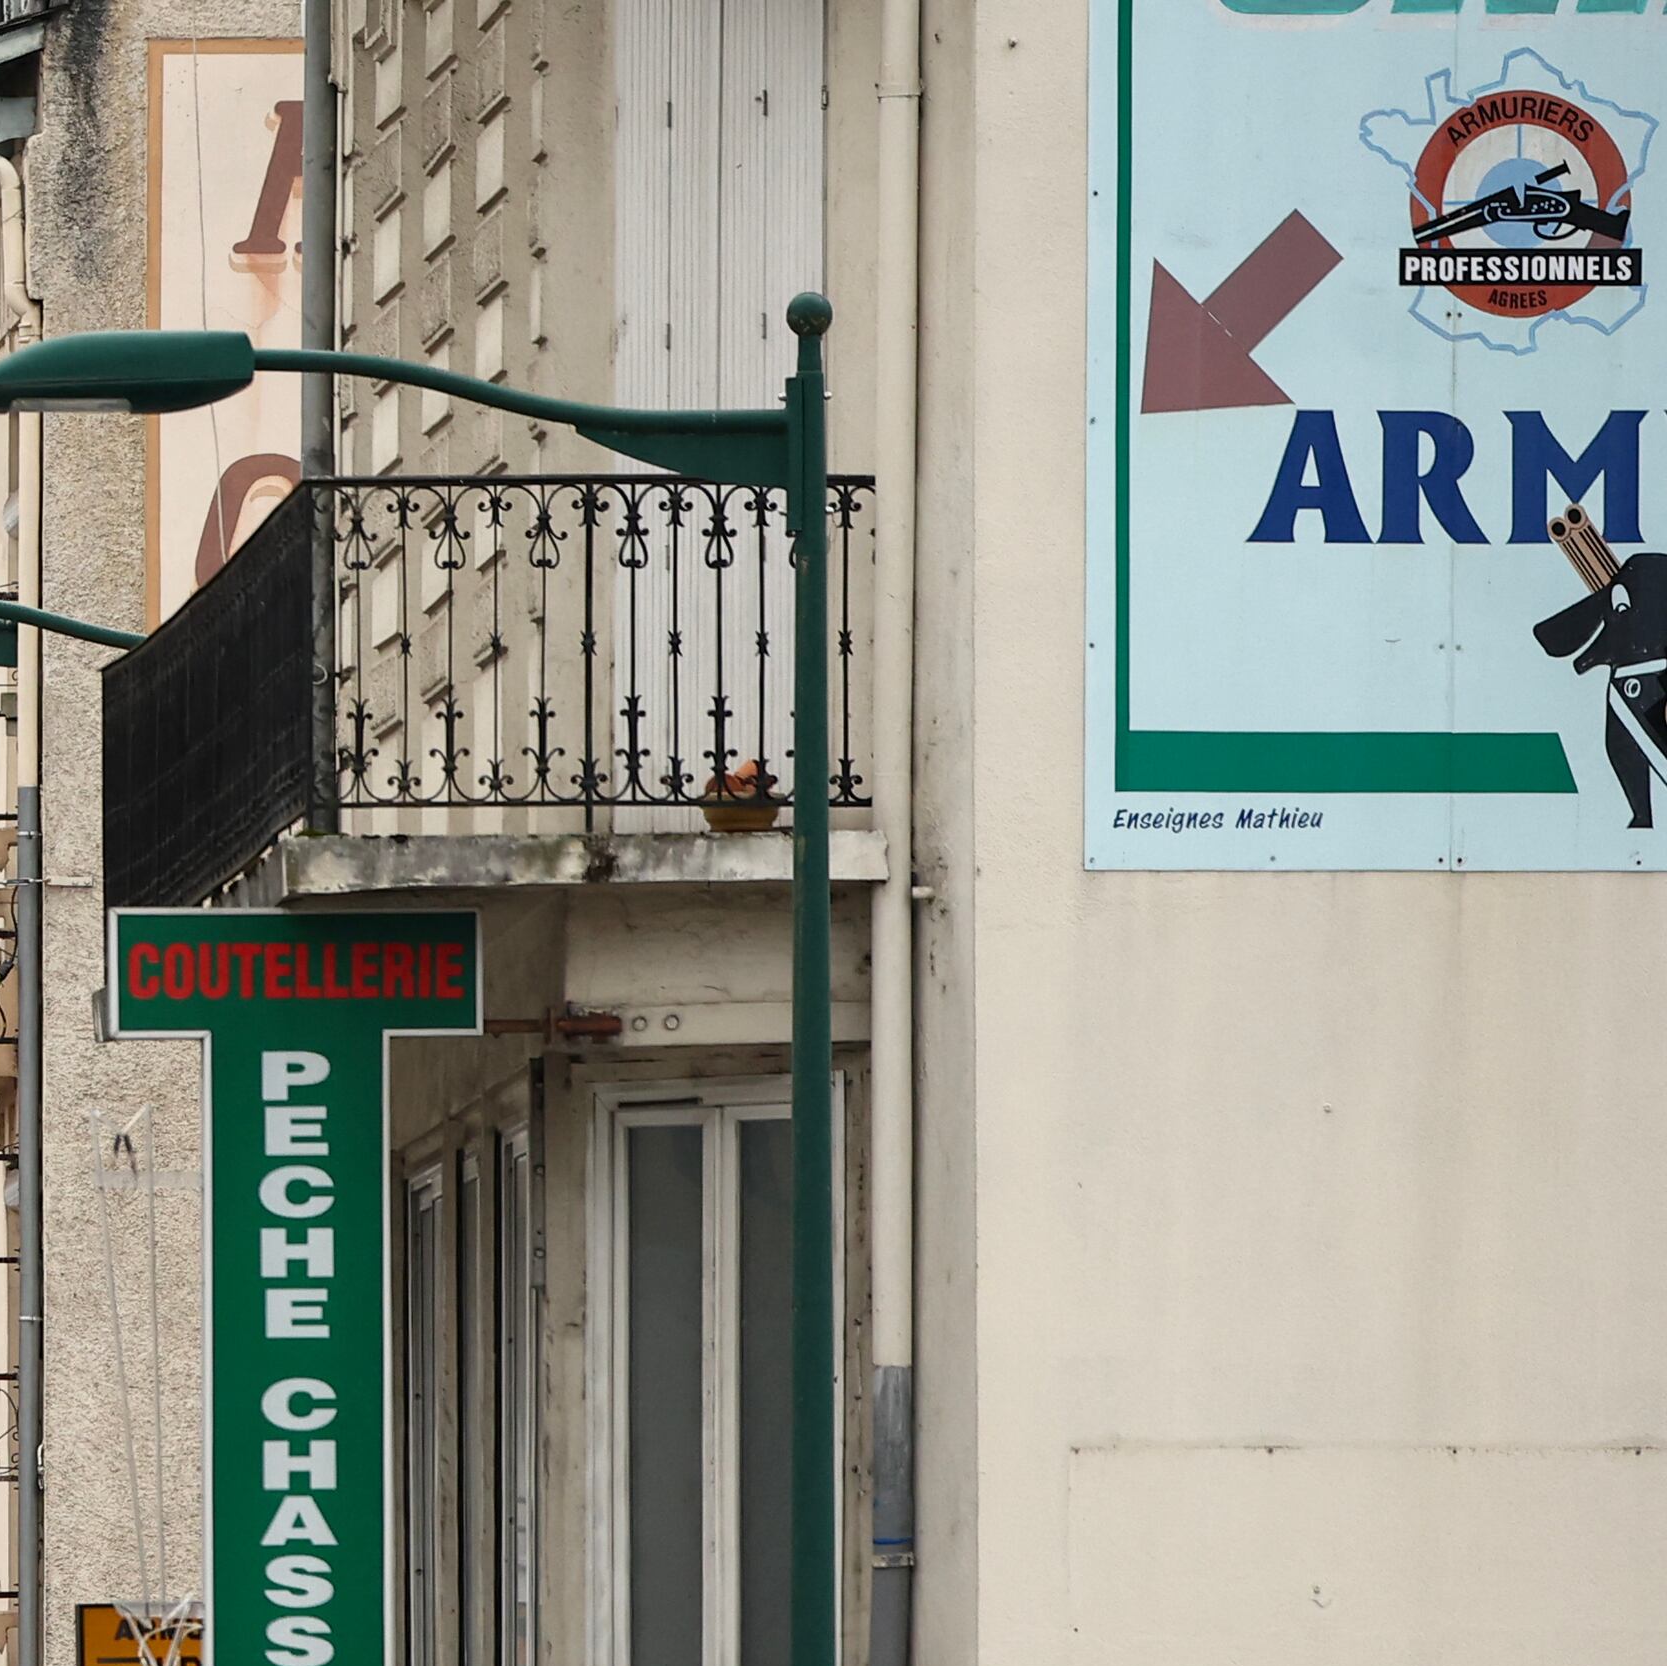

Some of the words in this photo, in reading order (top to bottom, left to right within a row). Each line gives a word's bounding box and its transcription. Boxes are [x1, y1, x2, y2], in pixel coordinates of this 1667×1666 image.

[1444, 96, 1595, 147] ARMURIERS
[1404, 254, 1633, 284] PROFESSIONNELS
[1487, 287, 1549, 310] AGREES
[1245, 409, 1667, 545] ARM
[1112, 808, 1224, 832] Enseignes
[1235, 808, 1324, 831] Mathieu
[127, 941, 464, 1000] COUTELLERIE
[259, 1050, 335, 1339] PECHE
